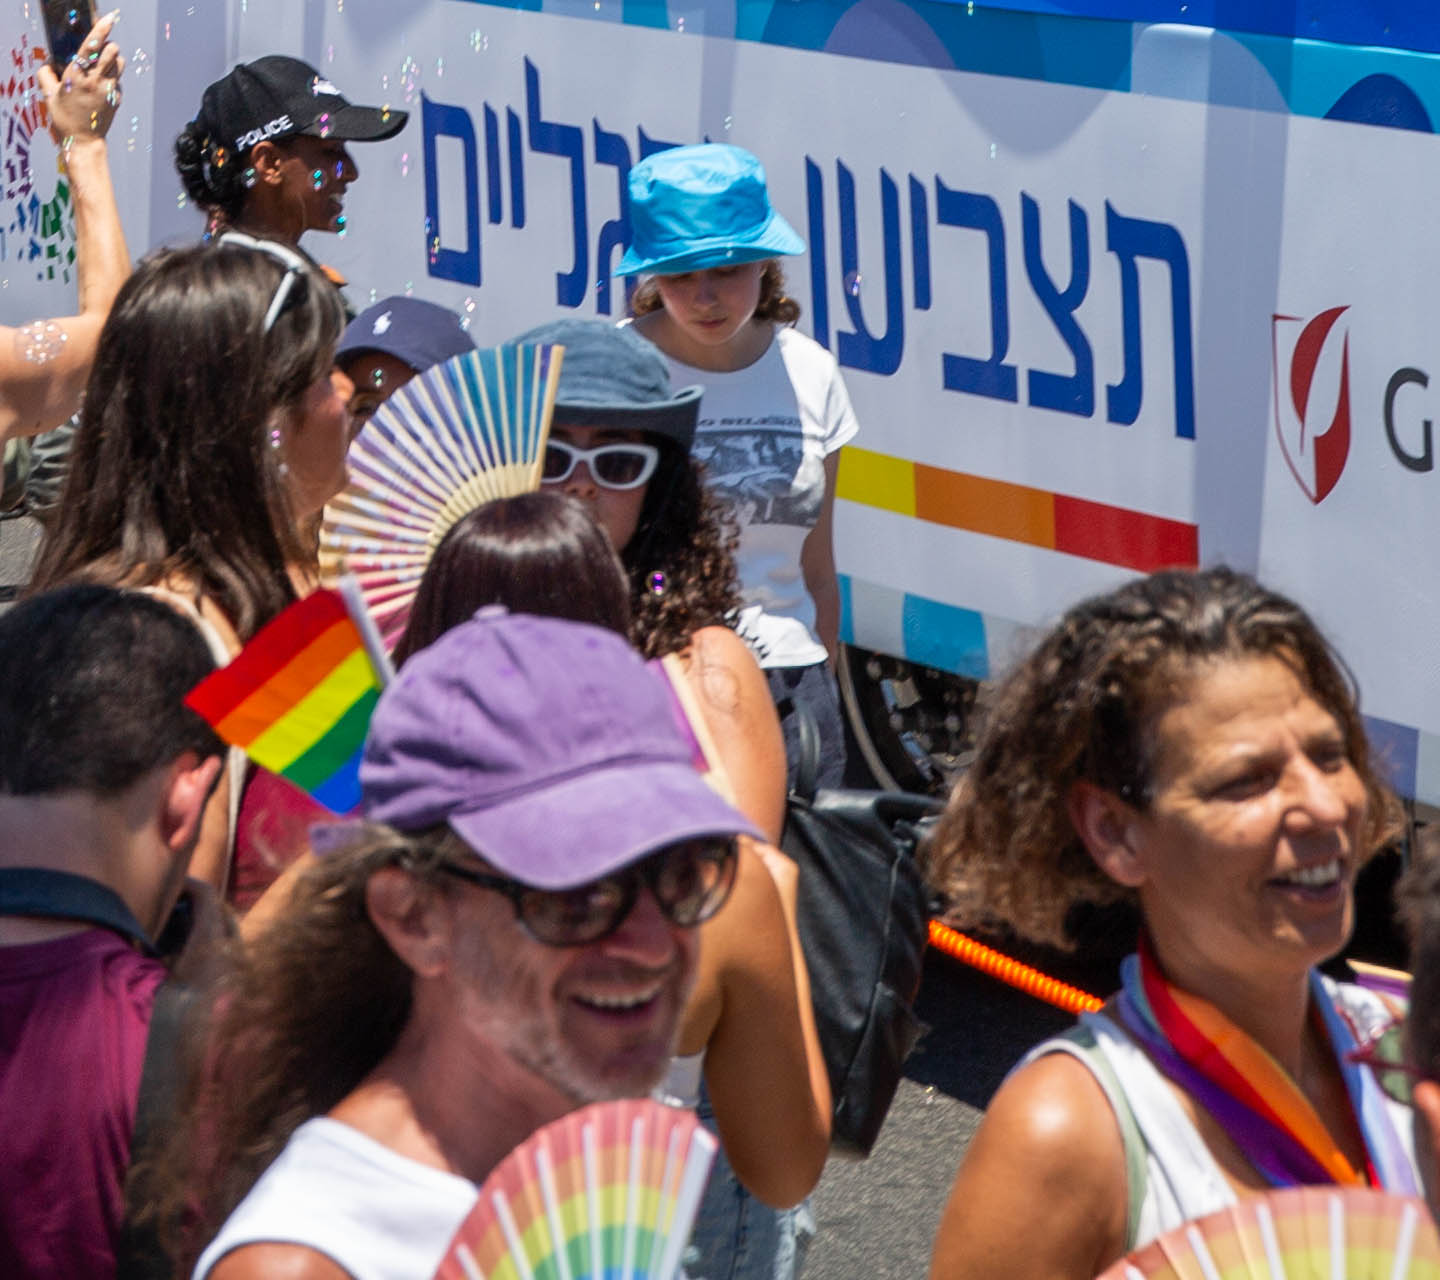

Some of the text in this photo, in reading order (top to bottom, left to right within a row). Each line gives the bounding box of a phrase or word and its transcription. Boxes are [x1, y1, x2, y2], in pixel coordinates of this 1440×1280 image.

[235, 114, 294, 152] POLICE
[420, 54, 1198, 441] תצביעו גליים
